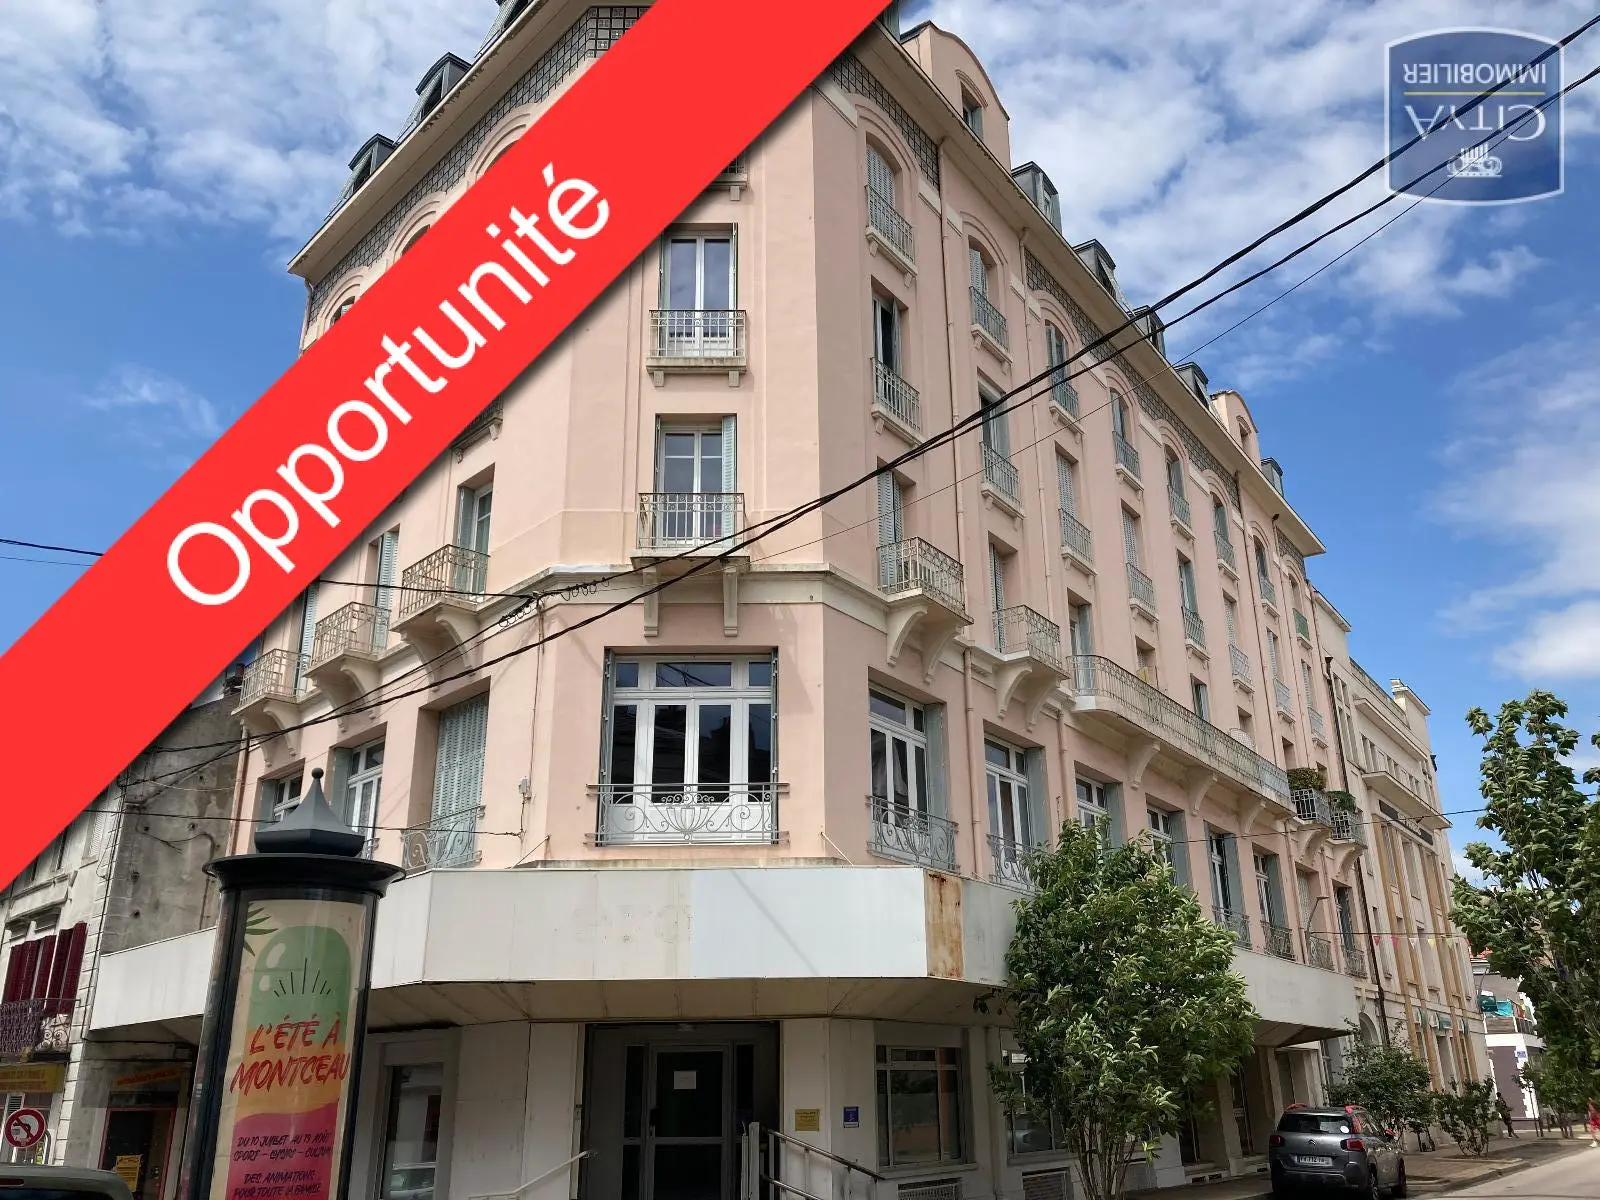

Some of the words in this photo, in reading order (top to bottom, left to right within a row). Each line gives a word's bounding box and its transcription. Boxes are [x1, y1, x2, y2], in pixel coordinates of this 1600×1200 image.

[249, 1013, 319, 1055] L'ÉTÉ
[322, 1012, 341, 1049] À
[229, 1052, 351, 1096] MONTCEAU
